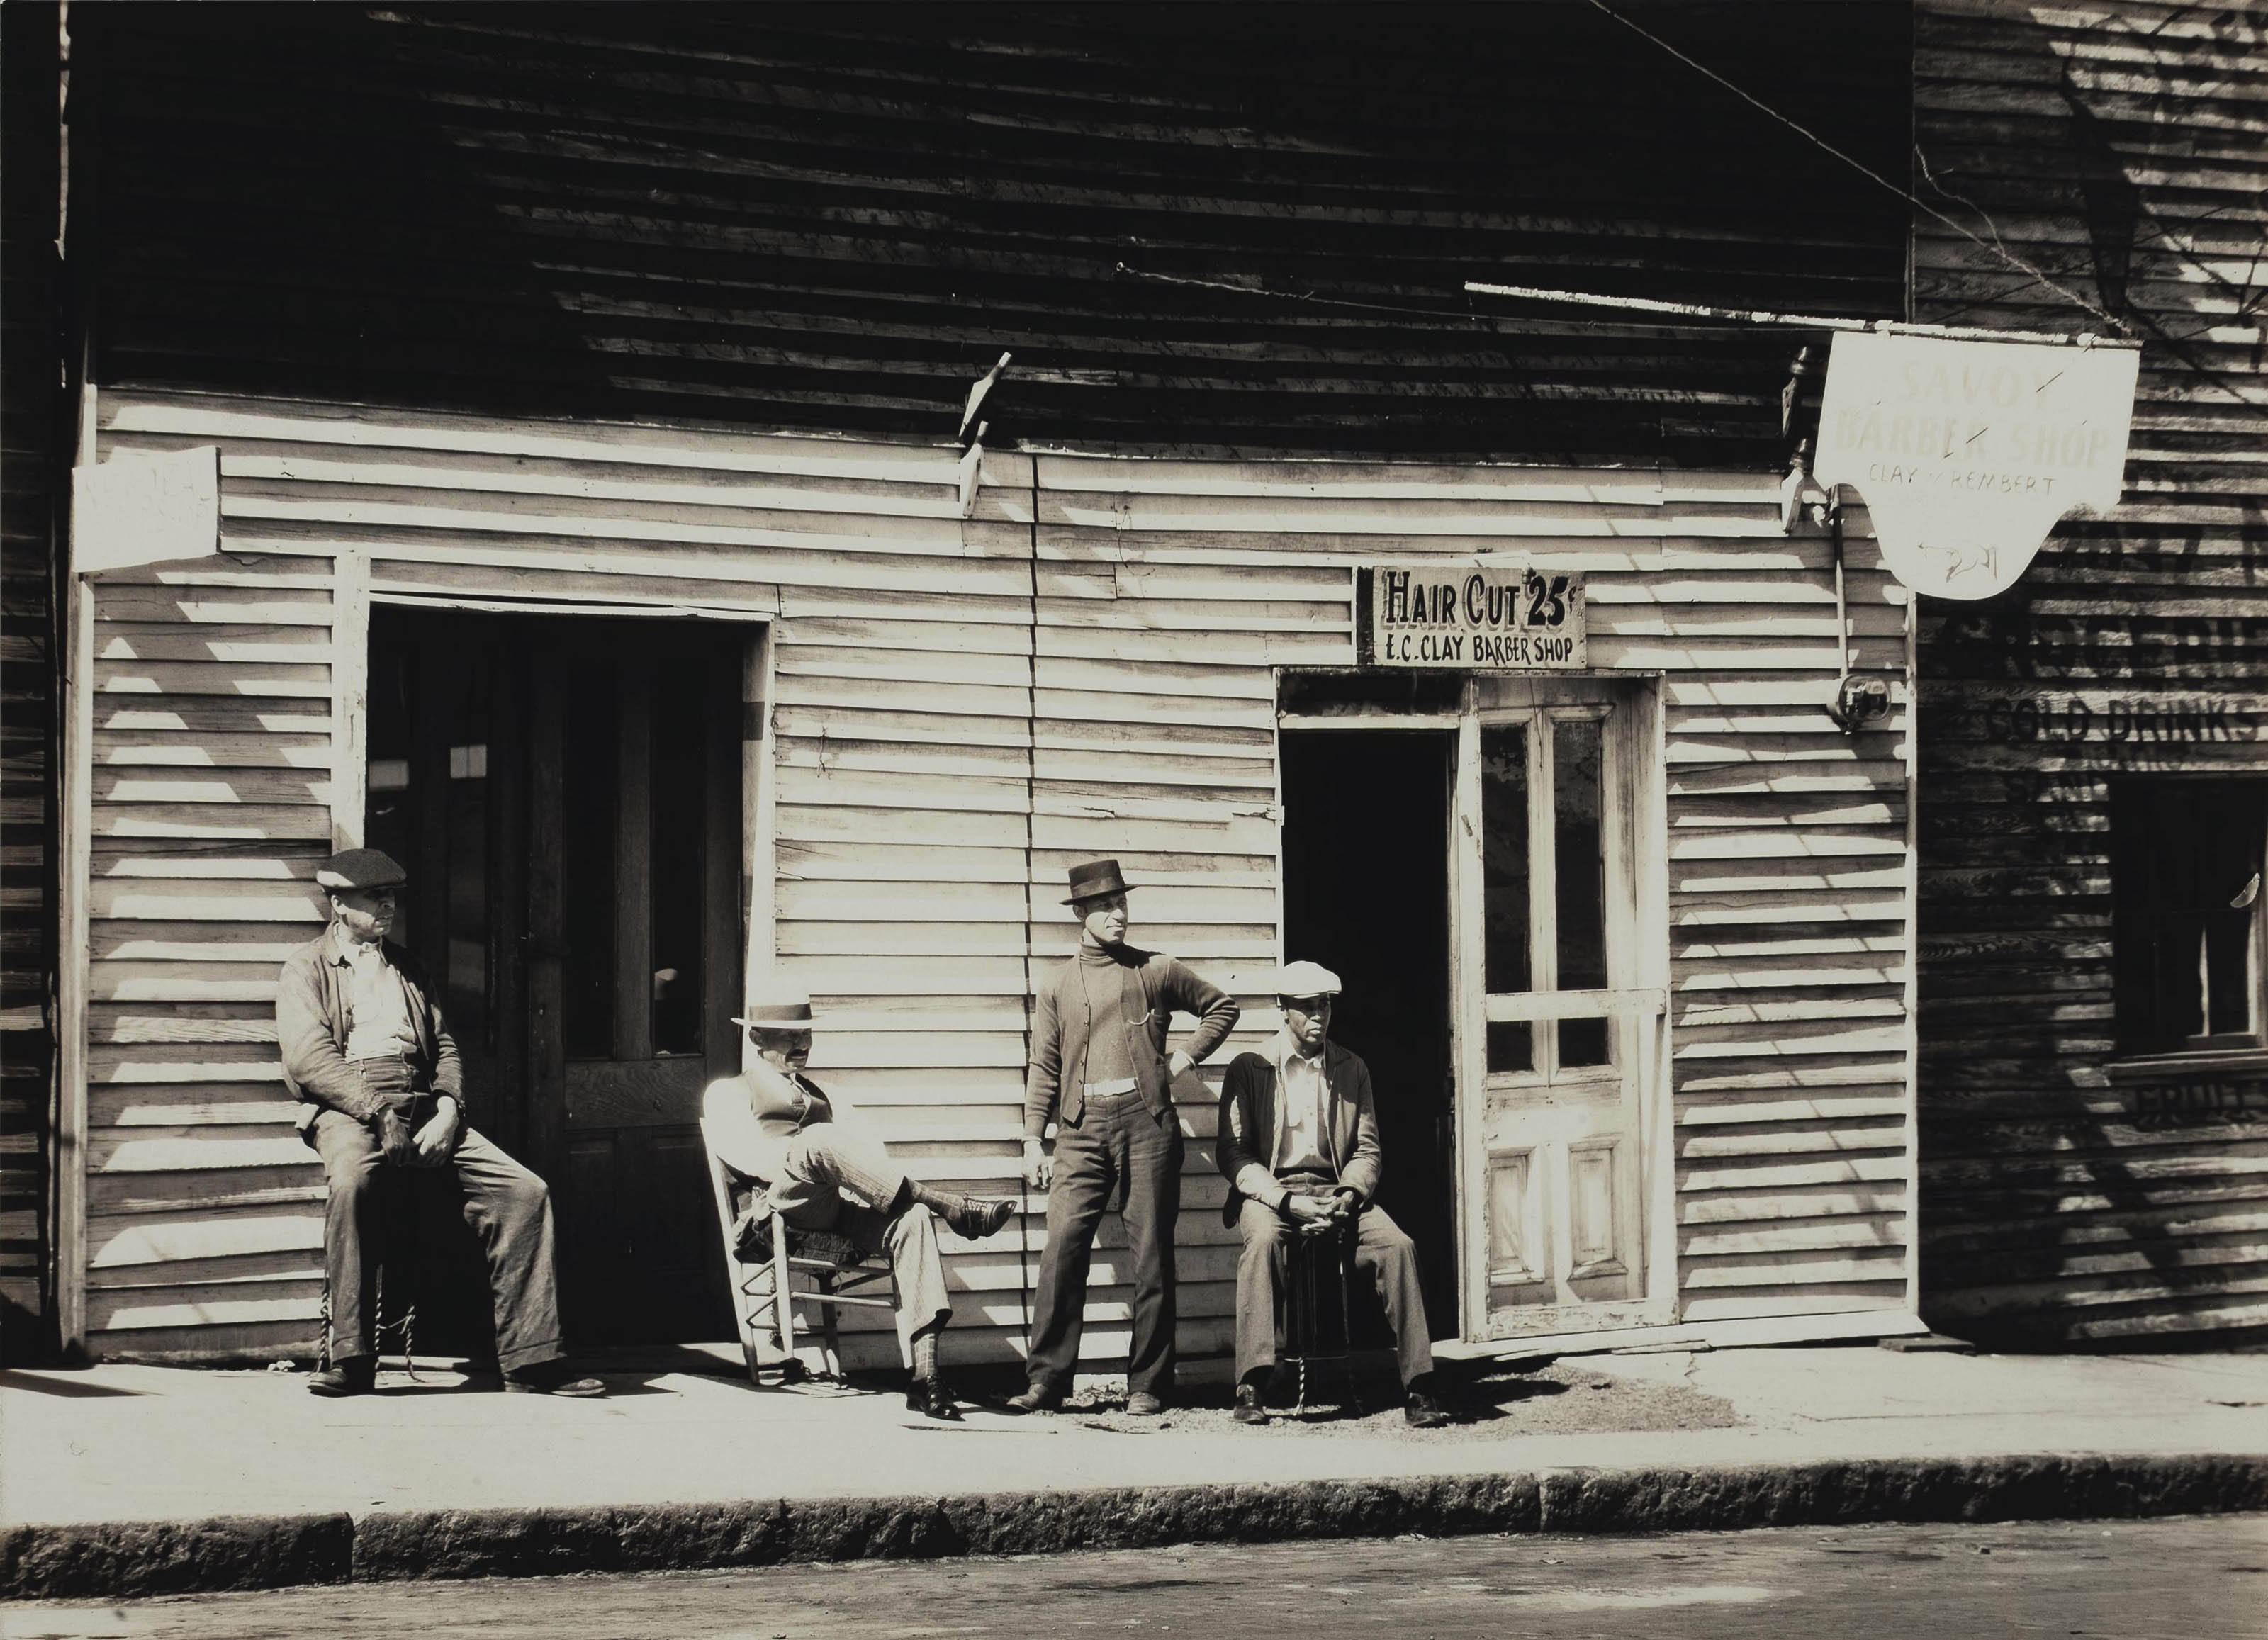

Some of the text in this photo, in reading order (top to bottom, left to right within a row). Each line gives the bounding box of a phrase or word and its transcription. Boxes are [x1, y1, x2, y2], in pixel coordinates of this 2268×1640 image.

[1897, 359, 2061, 410] SAVOY
[1834, 408, 2111, 468] BARBER SHOP
[1869, 463, 1918, 484] CLAY
[1950, 470, 2058, 496] REMBERT
[1383, 570, 1457, 629] HAIR
[1463, 573, 1521, 630] CUT
[1473, 635, 1532, 666] BARBER
[1534, 636, 1573, 663] SHOP
[2107, 697, 2258, 743] DRINKS
